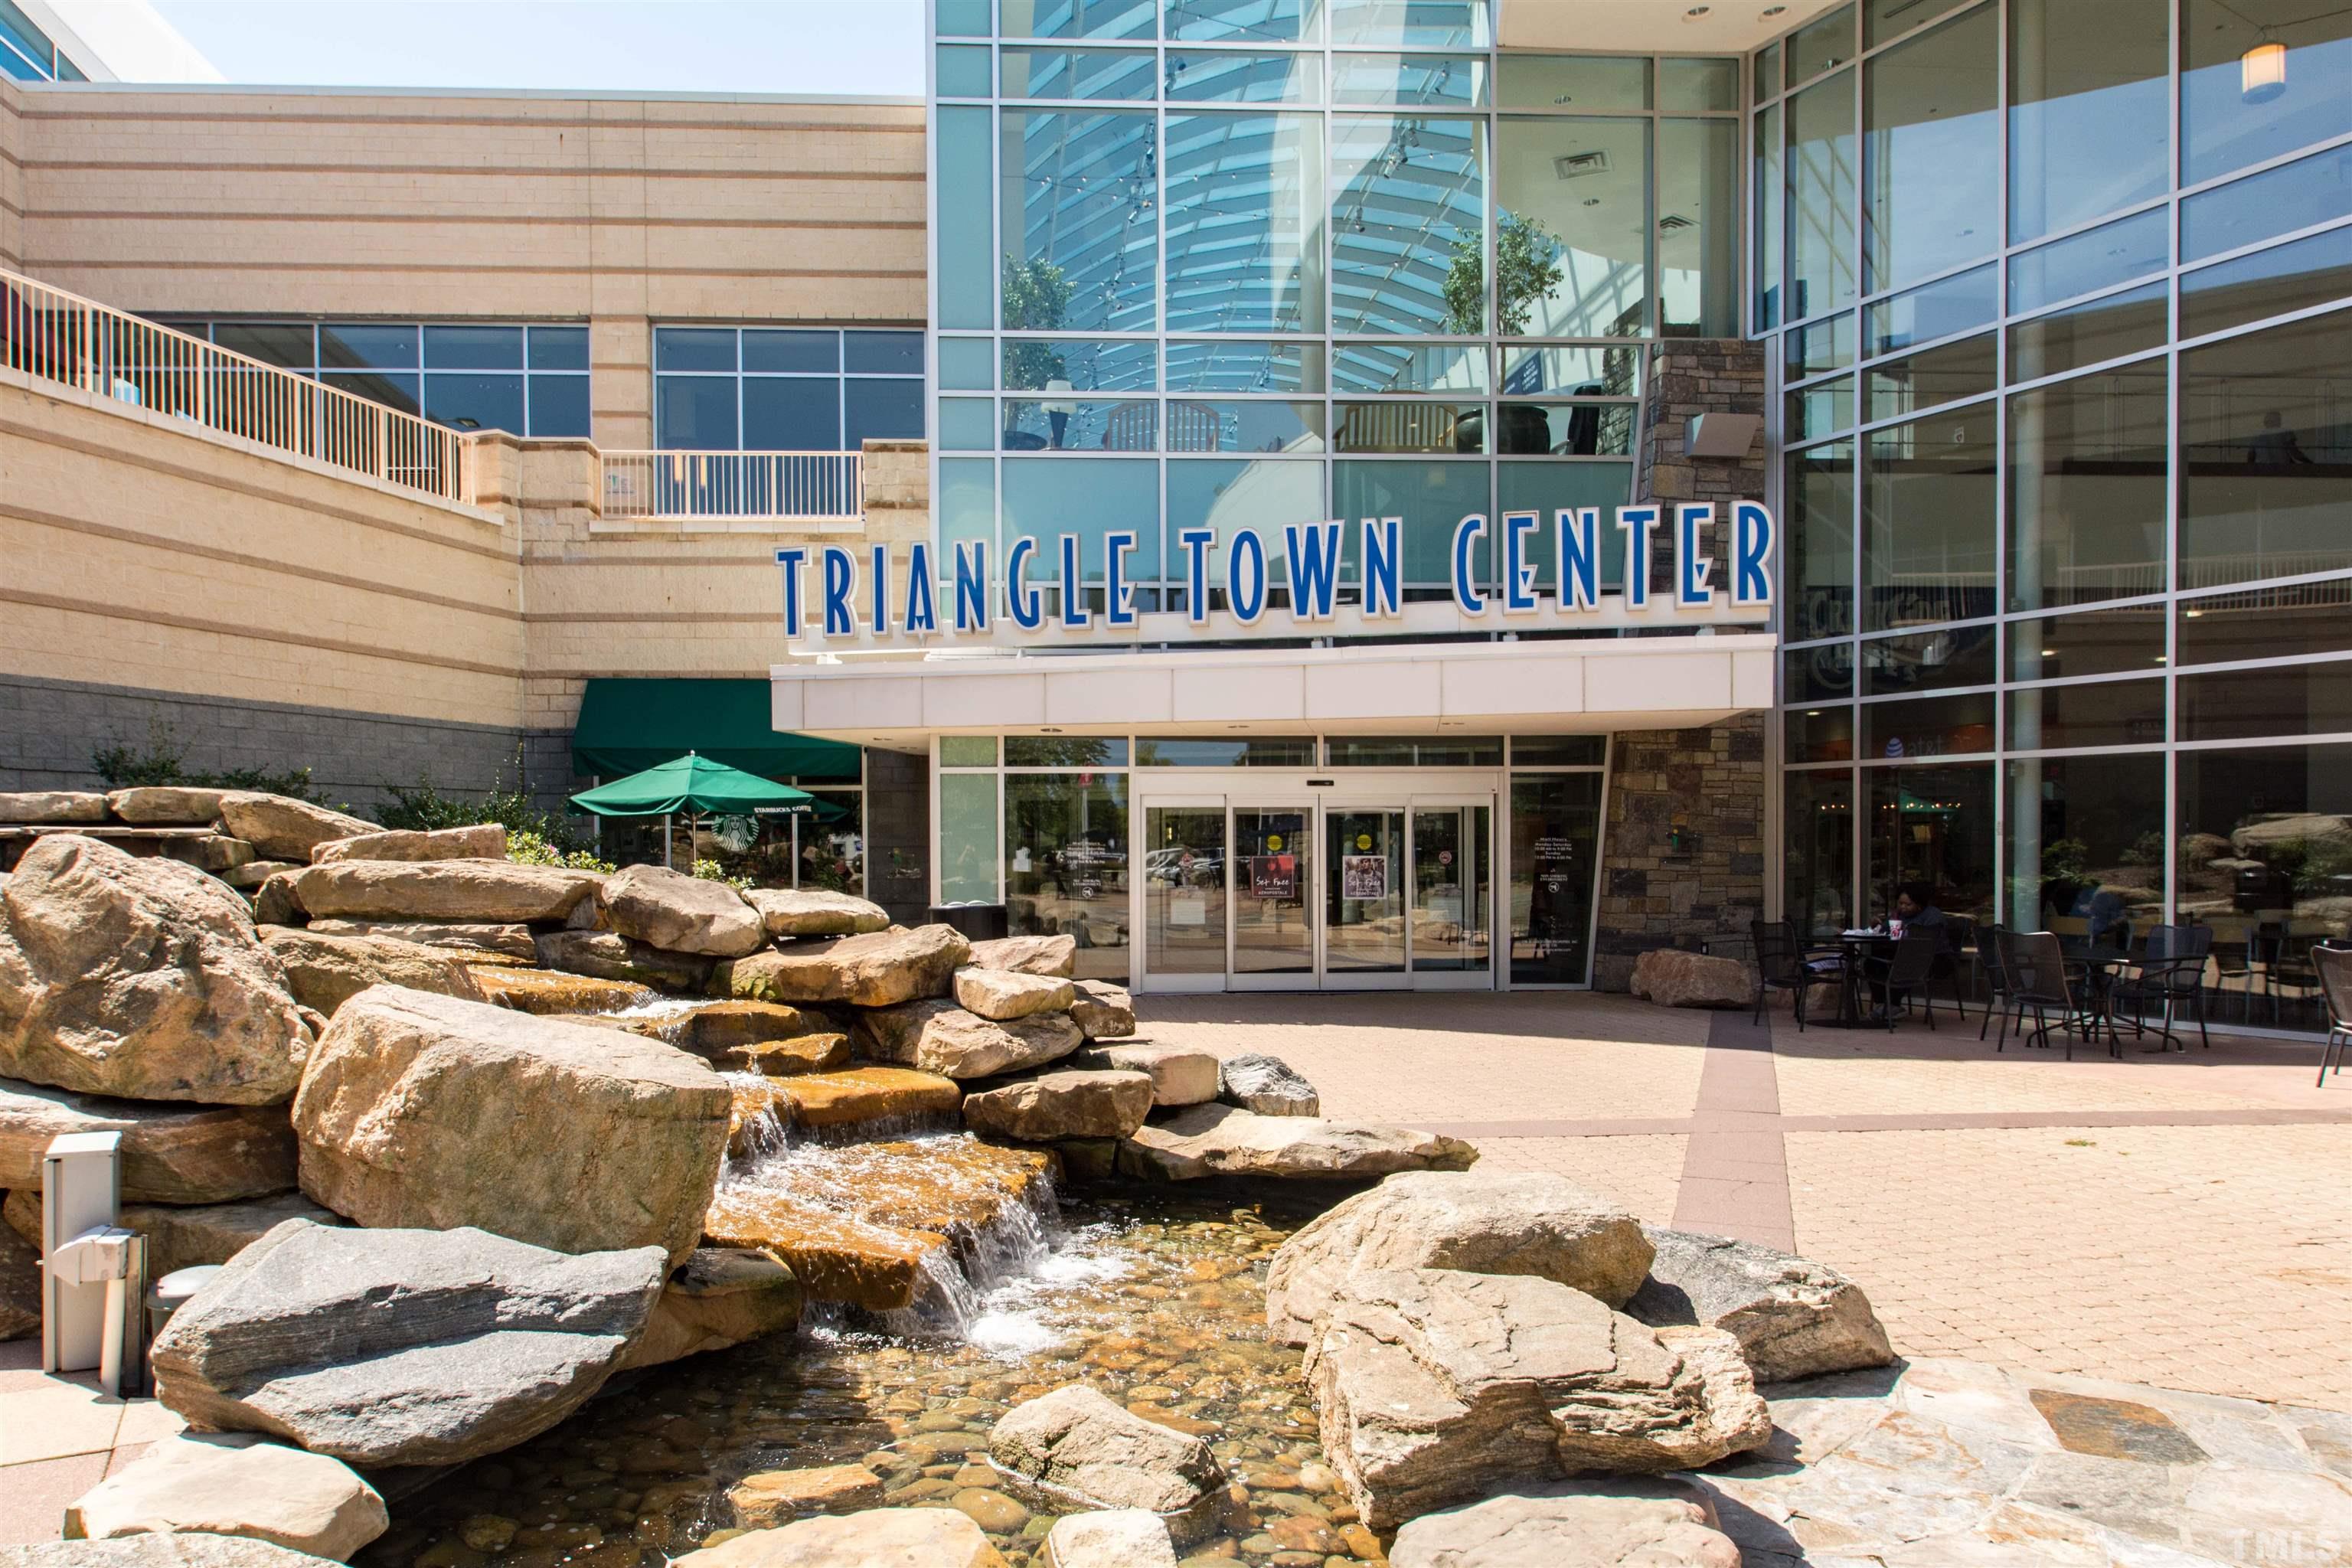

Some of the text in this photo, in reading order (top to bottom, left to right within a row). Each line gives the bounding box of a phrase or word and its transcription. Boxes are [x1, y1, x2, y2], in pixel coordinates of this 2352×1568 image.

[775, 529, 1138, 639] TRIANGLE
[1178, 517, 1403, 627] TOWN
[1451, 500, 1775, 617] CENTER
[1907, 735, 1945, 756] at&t
[1256, 875, 1289, 887] Set Free
